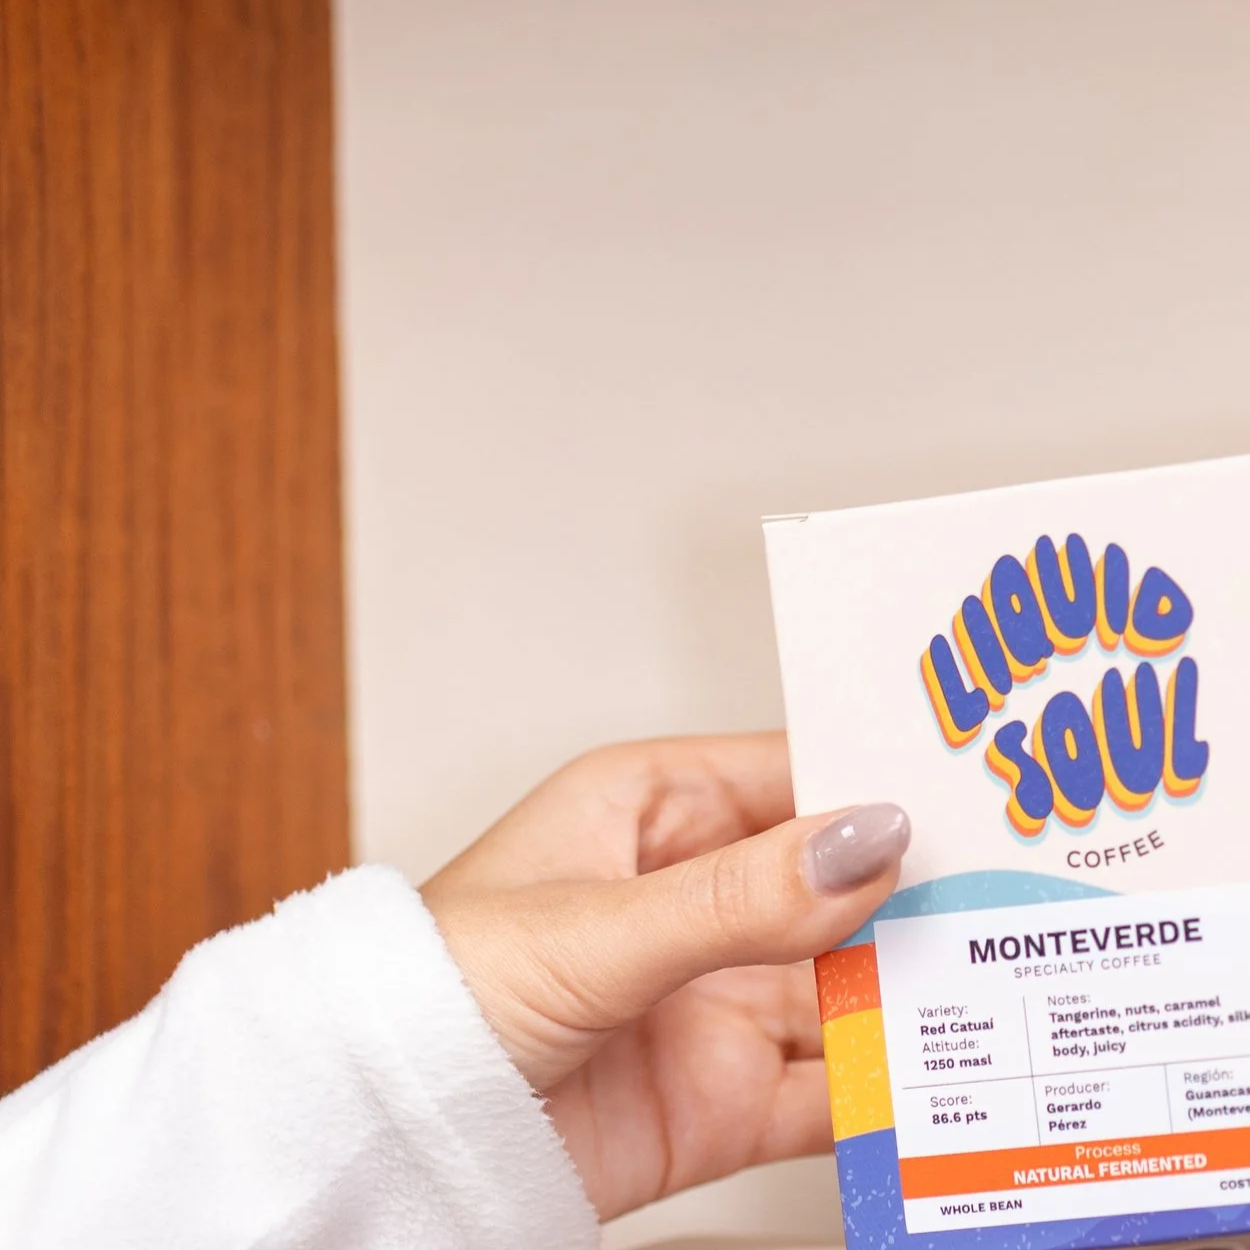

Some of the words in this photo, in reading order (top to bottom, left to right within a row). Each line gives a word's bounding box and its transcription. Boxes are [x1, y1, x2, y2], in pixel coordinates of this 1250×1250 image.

[919, 533, 1194, 752] LIQUID
[984, 656, 1210, 842] SOUL
[1066, 830, 1165, 868] COFFEE
[969, 917, 1203, 965] MONTEVERDE
[1014, 960, 1095, 979] SPECIALTY
[1101, 953, 1162, 972] COFFEE
[1047, 993, 1091, 1007] Notes:
[918, 1003, 969, 1019] Variety:
[1049, 1006, 1121, 1024] Tangerine,
[1125, 1003, 1160, 1016] nuts,
[1164, 996, 1221, 1013] caramel
[920, 1023, 946, 1036] Red
[950, 1017, 994, 1034] Catuaí
[1051, 1024, 1125, 1040] aftertaste,
[1128, 1020, 1168, 1033] citrus
[1173, 1014, 1224, 1029] acidity,
[922, 1037, 980, 1054] Altitude:
[1053, 1045, 1090, 1058] body,
[1092, 1040, 1127, 1055] juicy
[923, 1058, 955, 1072] 1250
[959, 1054, 992, 1068] masl
[1184, 1069, 1234, 1086] Región:
[1045, 1081, 1110, 1097] Producer:
[930, 1093, 972, 1108] Score:
[1047, 1099, 1102, 1114] Gerardo
[932, 1112, 961, 1125] 86.6
[966, 1109, 987, 1125] pts
[1049, 1118, 1087, 1132] Pérez
[1075, 1143, 1141, 1160] Process
[1013, 1163, 1095, 1185] NATURAL
[1098, 1153, 1208, 1177] FERMENTED
[940, 1202, 986, 1216] WHOLE
[990, 1199, 1023, 1212] BEAN
